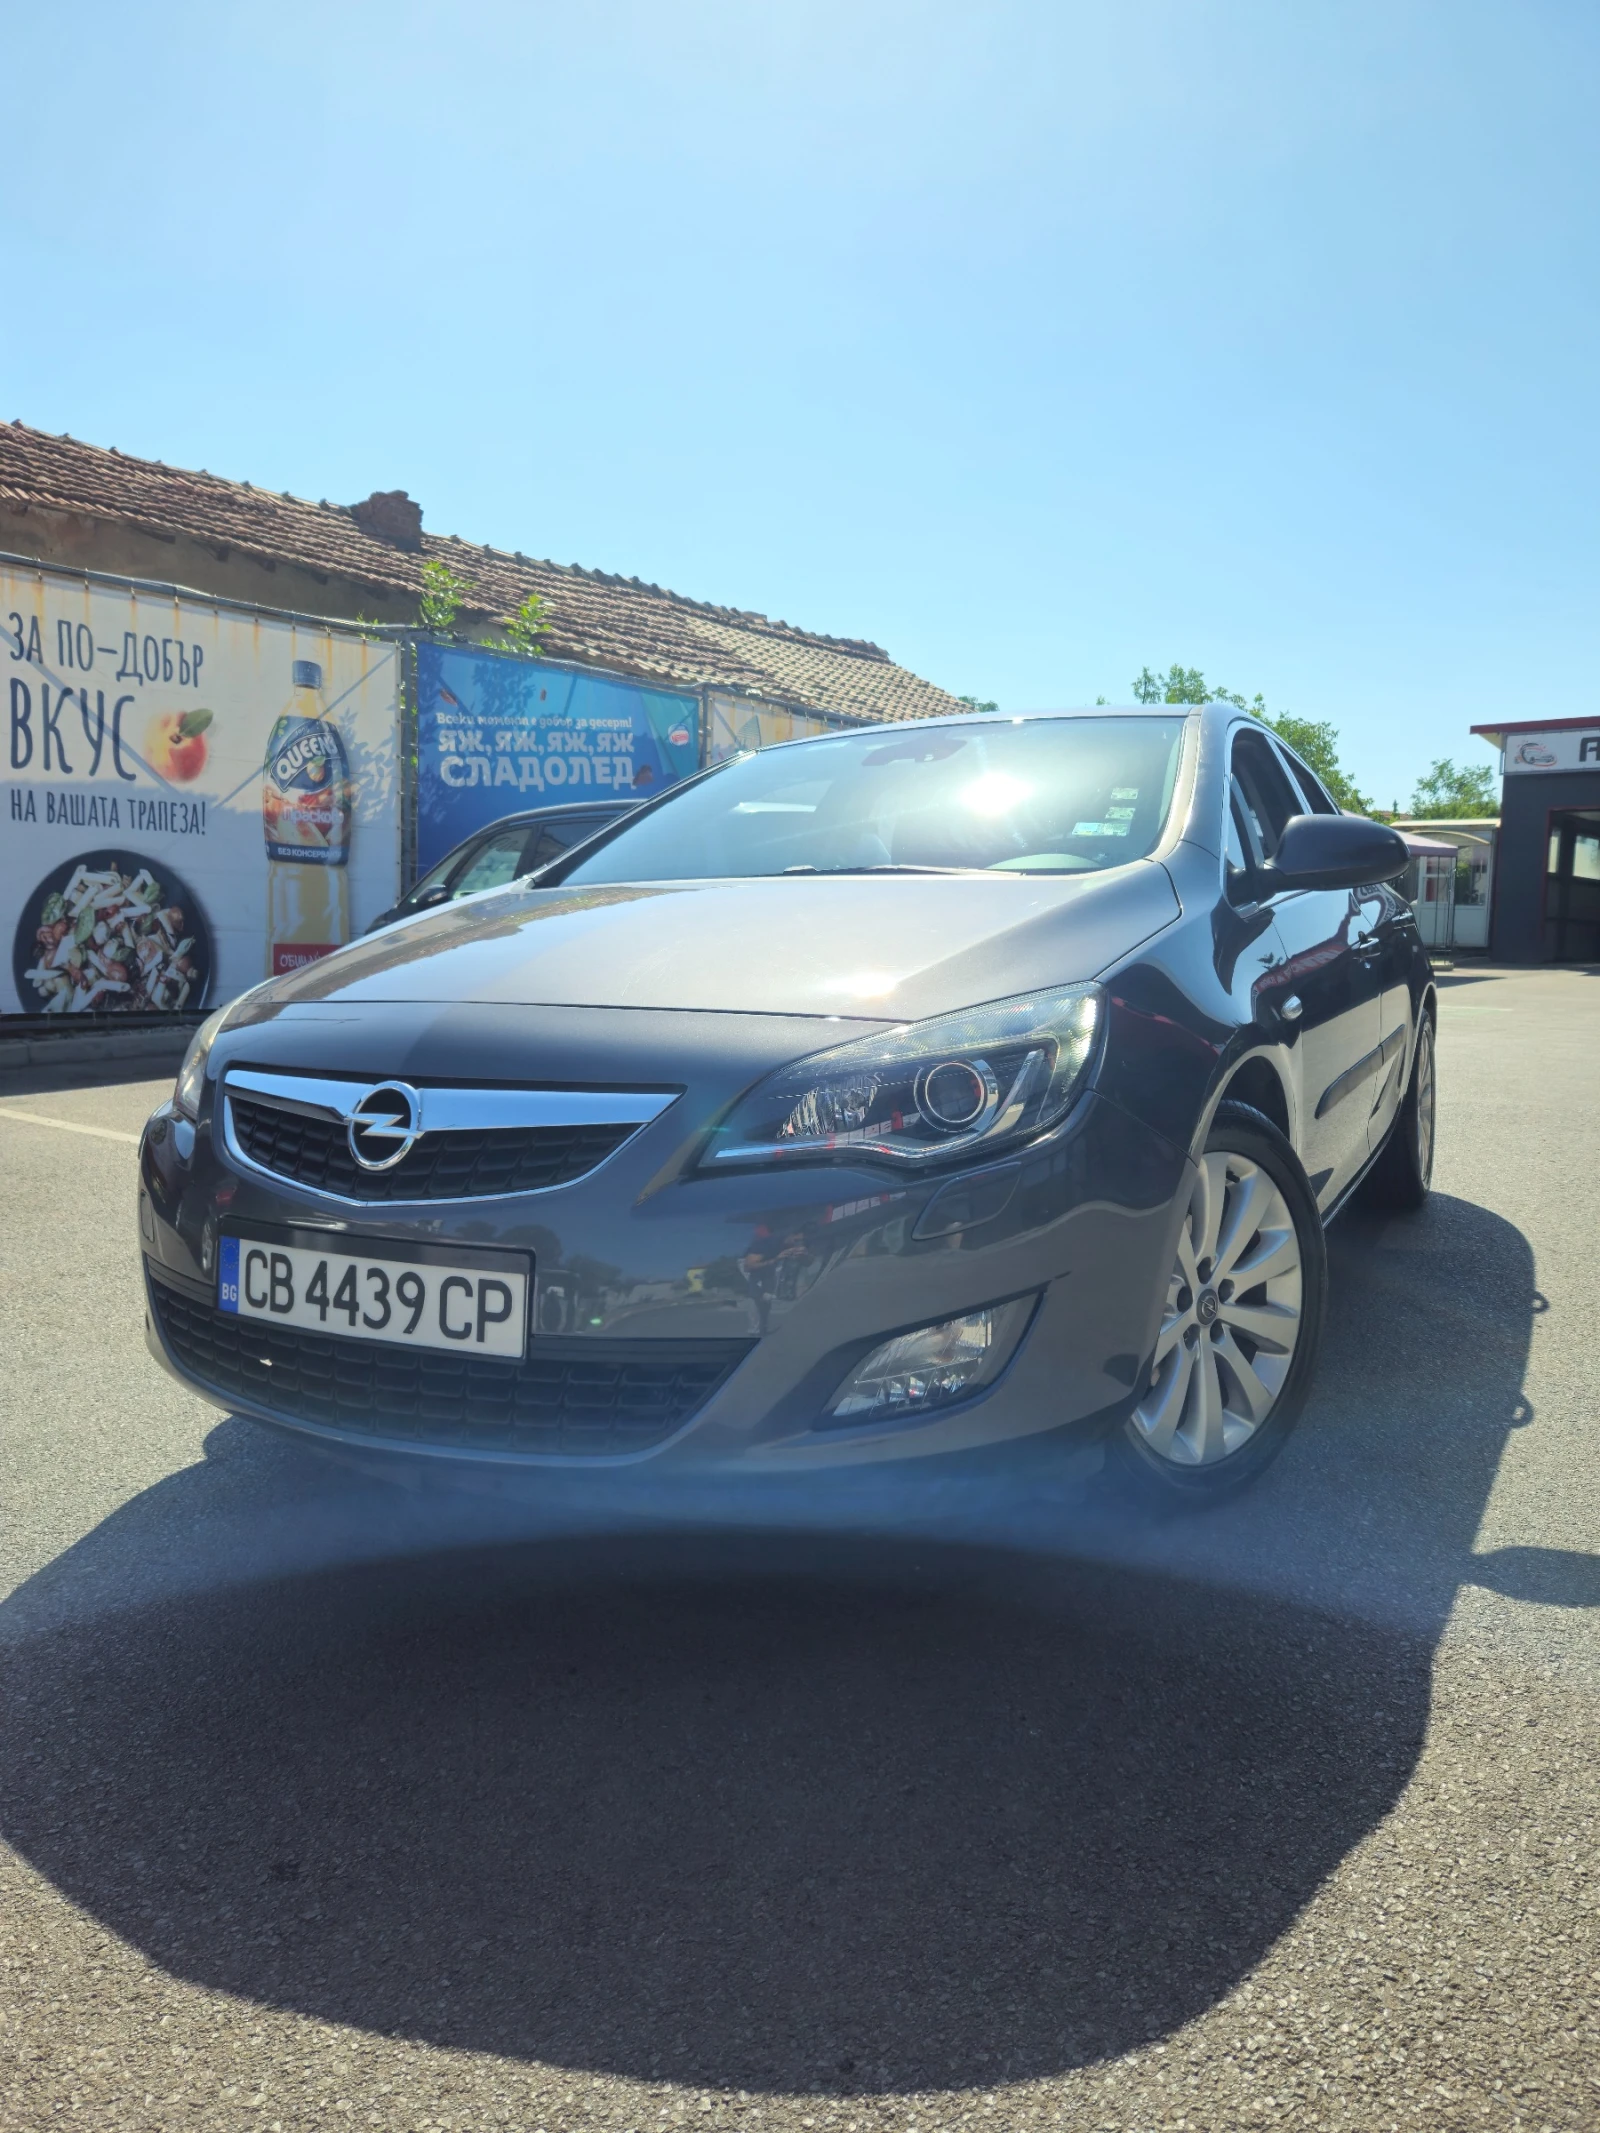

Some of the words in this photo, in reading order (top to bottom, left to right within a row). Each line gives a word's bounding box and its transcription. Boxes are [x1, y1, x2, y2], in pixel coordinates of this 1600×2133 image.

[9, 612, 43, 664] ЗА
[10, 677, 137, 781] ВКУС
[575, 718, 588, 730] за
[589, 716, 633, 730] десерт!
[438, 730, 492, 756] ЯЖ,
[495, 731, 545, 756] ЯЖ,
[547, 731, 594, 756] ЯЖ,
[597, 732, 635, 753] ЯЖ
[440, 755, 635, 792] СЛАДОЛЕД
[11, 788, 37, 823] НА
[46, 791, 120, 829] ВАШАТА
[127, 798, 206, 836] ТРАПЕЗА!
[277, 847, 291, 856] БЕЗ
[221, 1282, 237, 1302] BG
[245, 1249, 294, 1314] CB
[305, 1260, 425, 1334] 4439
[439, 1276, 512, 1342] CP
